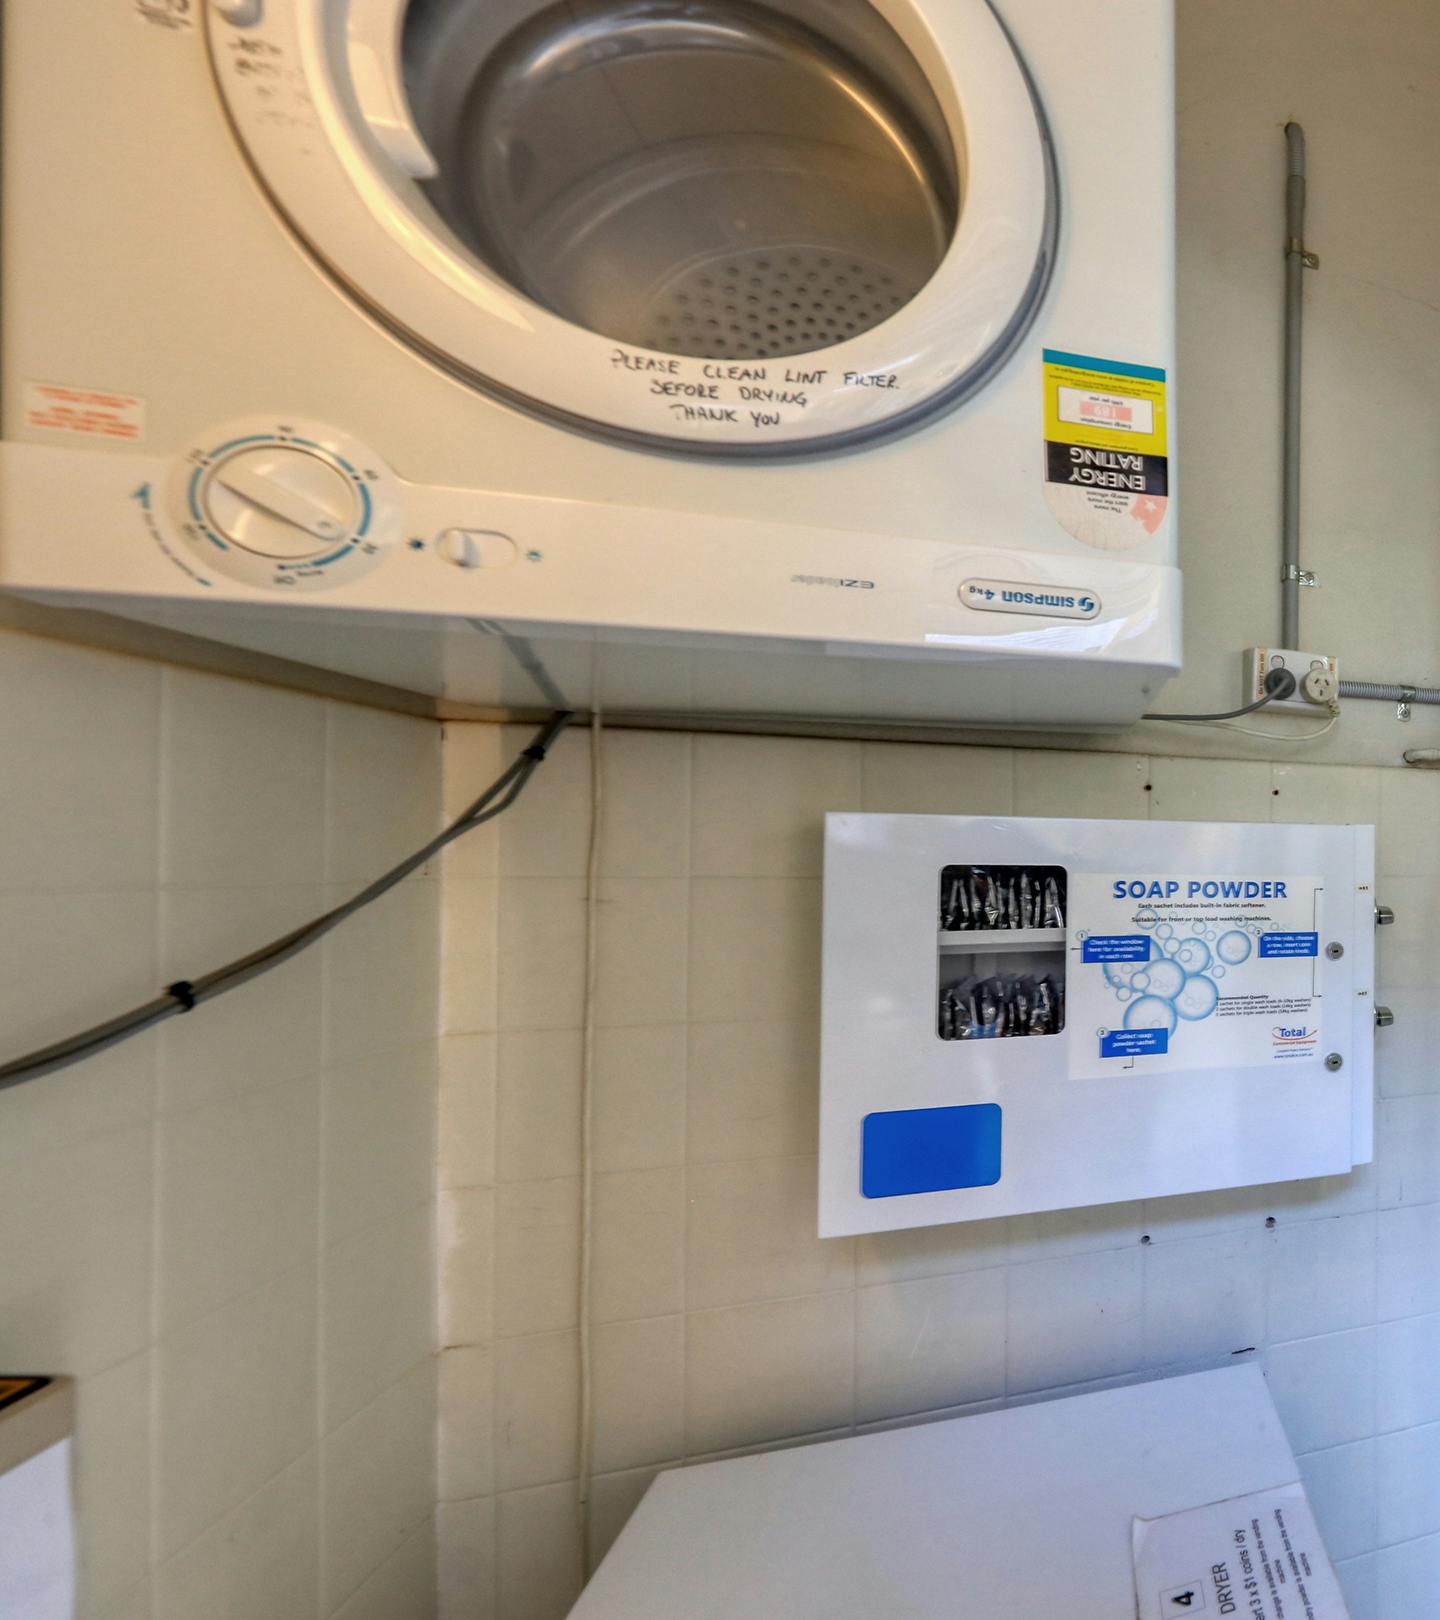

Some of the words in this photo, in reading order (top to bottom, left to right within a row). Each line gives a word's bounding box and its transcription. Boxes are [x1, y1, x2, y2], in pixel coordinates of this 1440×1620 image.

[611, 349, 681, 375] PLEASE
[703, 363, 767, 381] CLEAN
[785, 368, 828, 385] LINT
[740, 386, 808, 408] DRYING
[669, 404, 739, 423] THANK
[750, 411, 781, 428] YOU
[1069, 447, 1143, 471] RATING
[1068, 467, 1146, 490] ENERGY
[1113, 880, 1179, 899] SOAP
[1187, 881, 1288, 899] POWDER
[1279, 1026, 1306, 1038] Total
[1234, 1529, 1246, 1543] dry
[1240, 1550, 1252, 1574] coins
[1212, 1562, 1236, 1616] DRYER
[1243, 1576, 1257, 1590] $1
[1171, 1590, 1194, 1606] 4
[1250, 1598, 1262, 1606] 3
